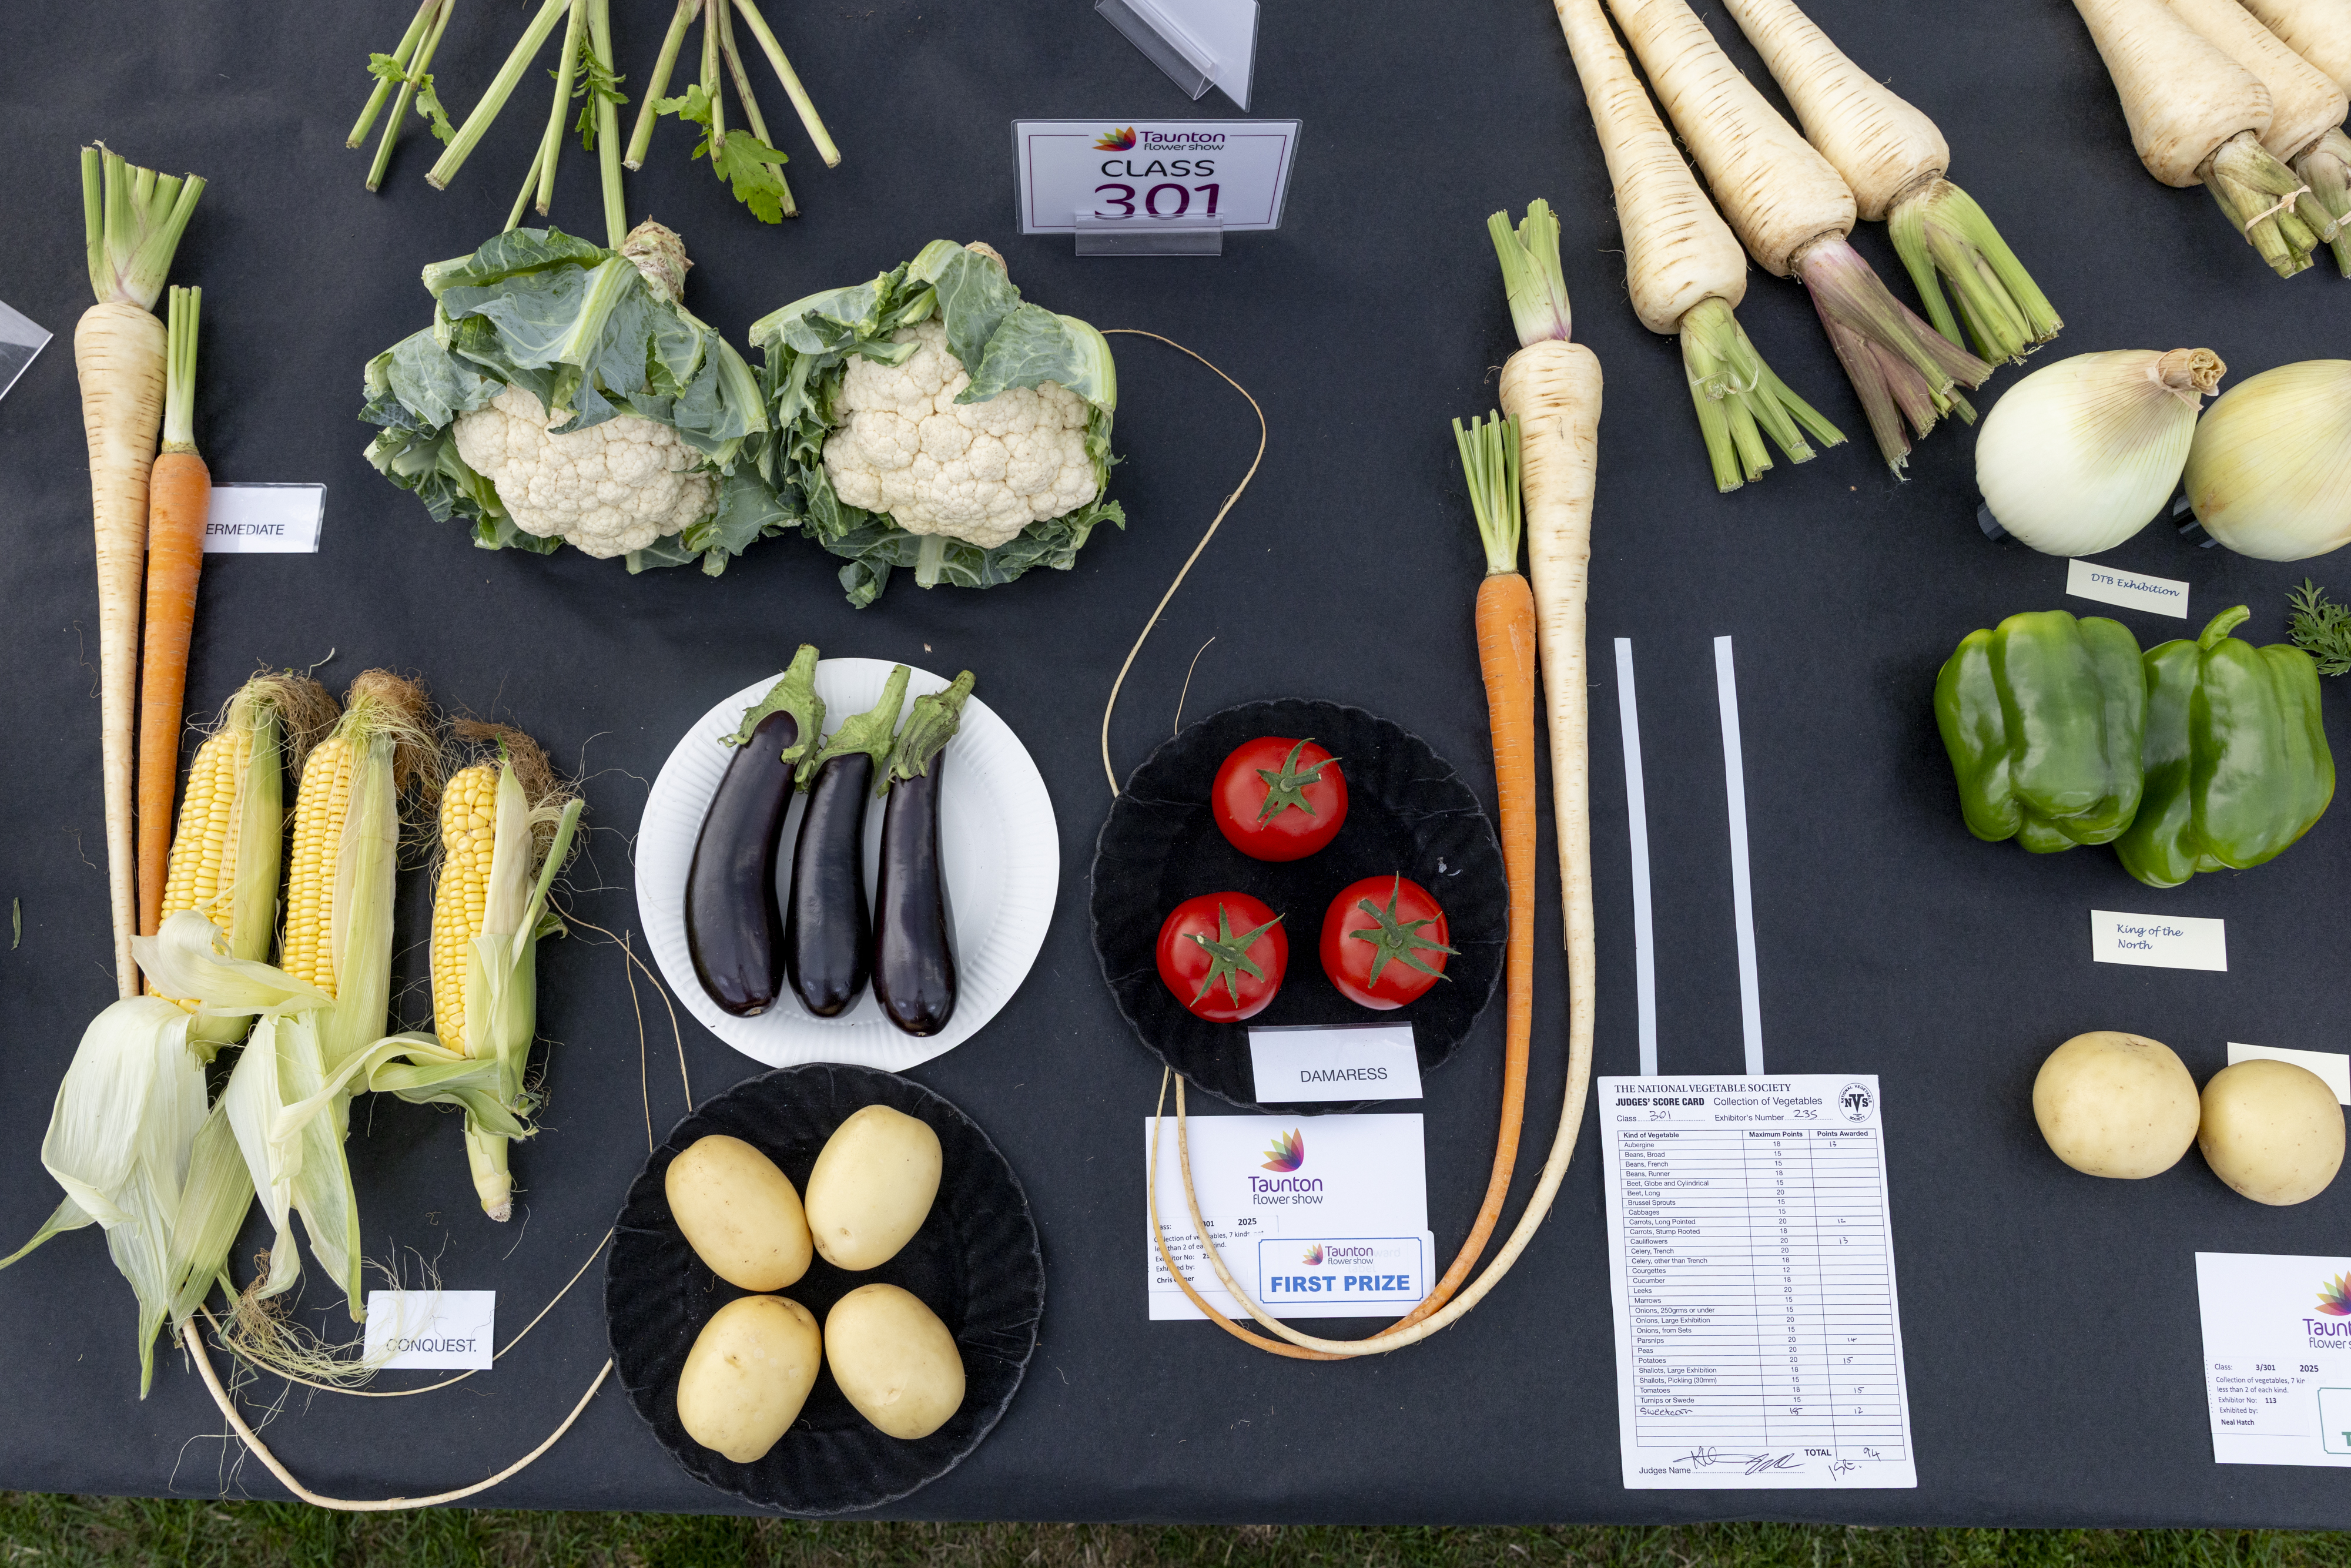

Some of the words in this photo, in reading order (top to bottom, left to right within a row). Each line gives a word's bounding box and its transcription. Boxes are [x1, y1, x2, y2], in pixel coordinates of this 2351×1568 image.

[1140, 130, 1225, 143] Taunton
[1144, 143, 1186, 151] flower
[1101, 159, 1215, 177] CLASS
[1094, 183, 1220, 220] 301
[2091, 573, 2114, 585] DTB
[2117, 578, 2180, 597] Exhibition
[2116, 924, 2147, 937] King
[2148, 926, 2161, 937] of
[2162, 926, 2183, 937] the
[2118, 939, 2153, 950] North
[1300, 1067, 1388, 1083] DAMARESS
[1748, 1084, 1791, 1092] SOCIETY
[1616, 1098, 1650, 1106] JUDGES'
[1653, 1098, 1680, 1106] SCORE
[1713, 1097, 1759, 1105] Collection
[1761, 1097, 1770, 1105] of
[1773, 1097, 1823, 1107] Vegetables
[1844, 1094, 1868, 1113] NVS
[1649, 1110, 1671, 1121] 301
[1248, 1176, 1323, 1192] Taunton
[1253, 1194, 1291, 1205] flower
[1292, 1194, 1323, 1205] show
[1238, 1218, 1257, 1226] 2025
[1325, 1245, 1374, 1257] Taunton
[1271, 1276, 1336, 1292] FIRST
[1344, 1275, 1410, 1292] PRIZE
[2309, 1336, 2346, 1349] flower
[1639, 1467, 1667, 1476] Judges
